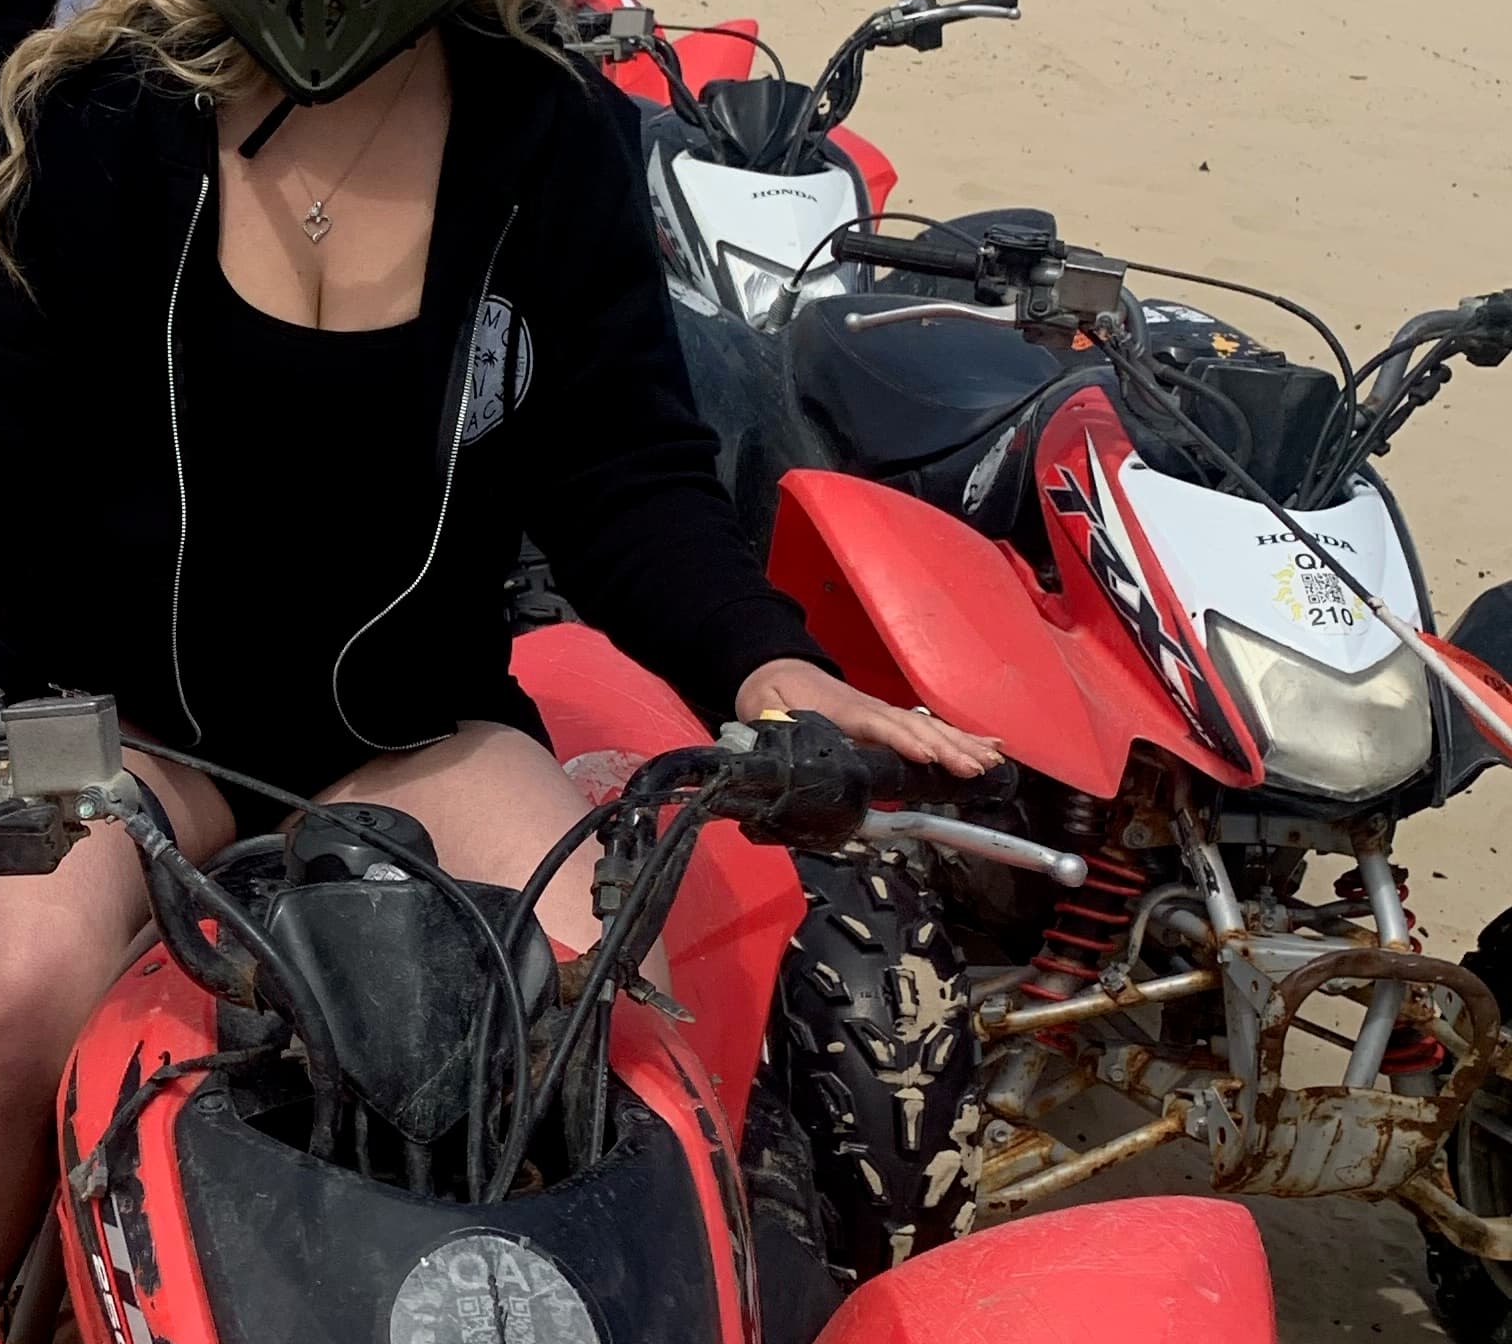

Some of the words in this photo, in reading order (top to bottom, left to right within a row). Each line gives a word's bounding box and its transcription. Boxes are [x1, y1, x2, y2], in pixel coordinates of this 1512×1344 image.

[751, 187, 818, 203] HONDA
[1256, 532, 1357, 554] HODA
[1308, 606, 1355, 627] 210
[448, 1251, 531, 1292] QA
